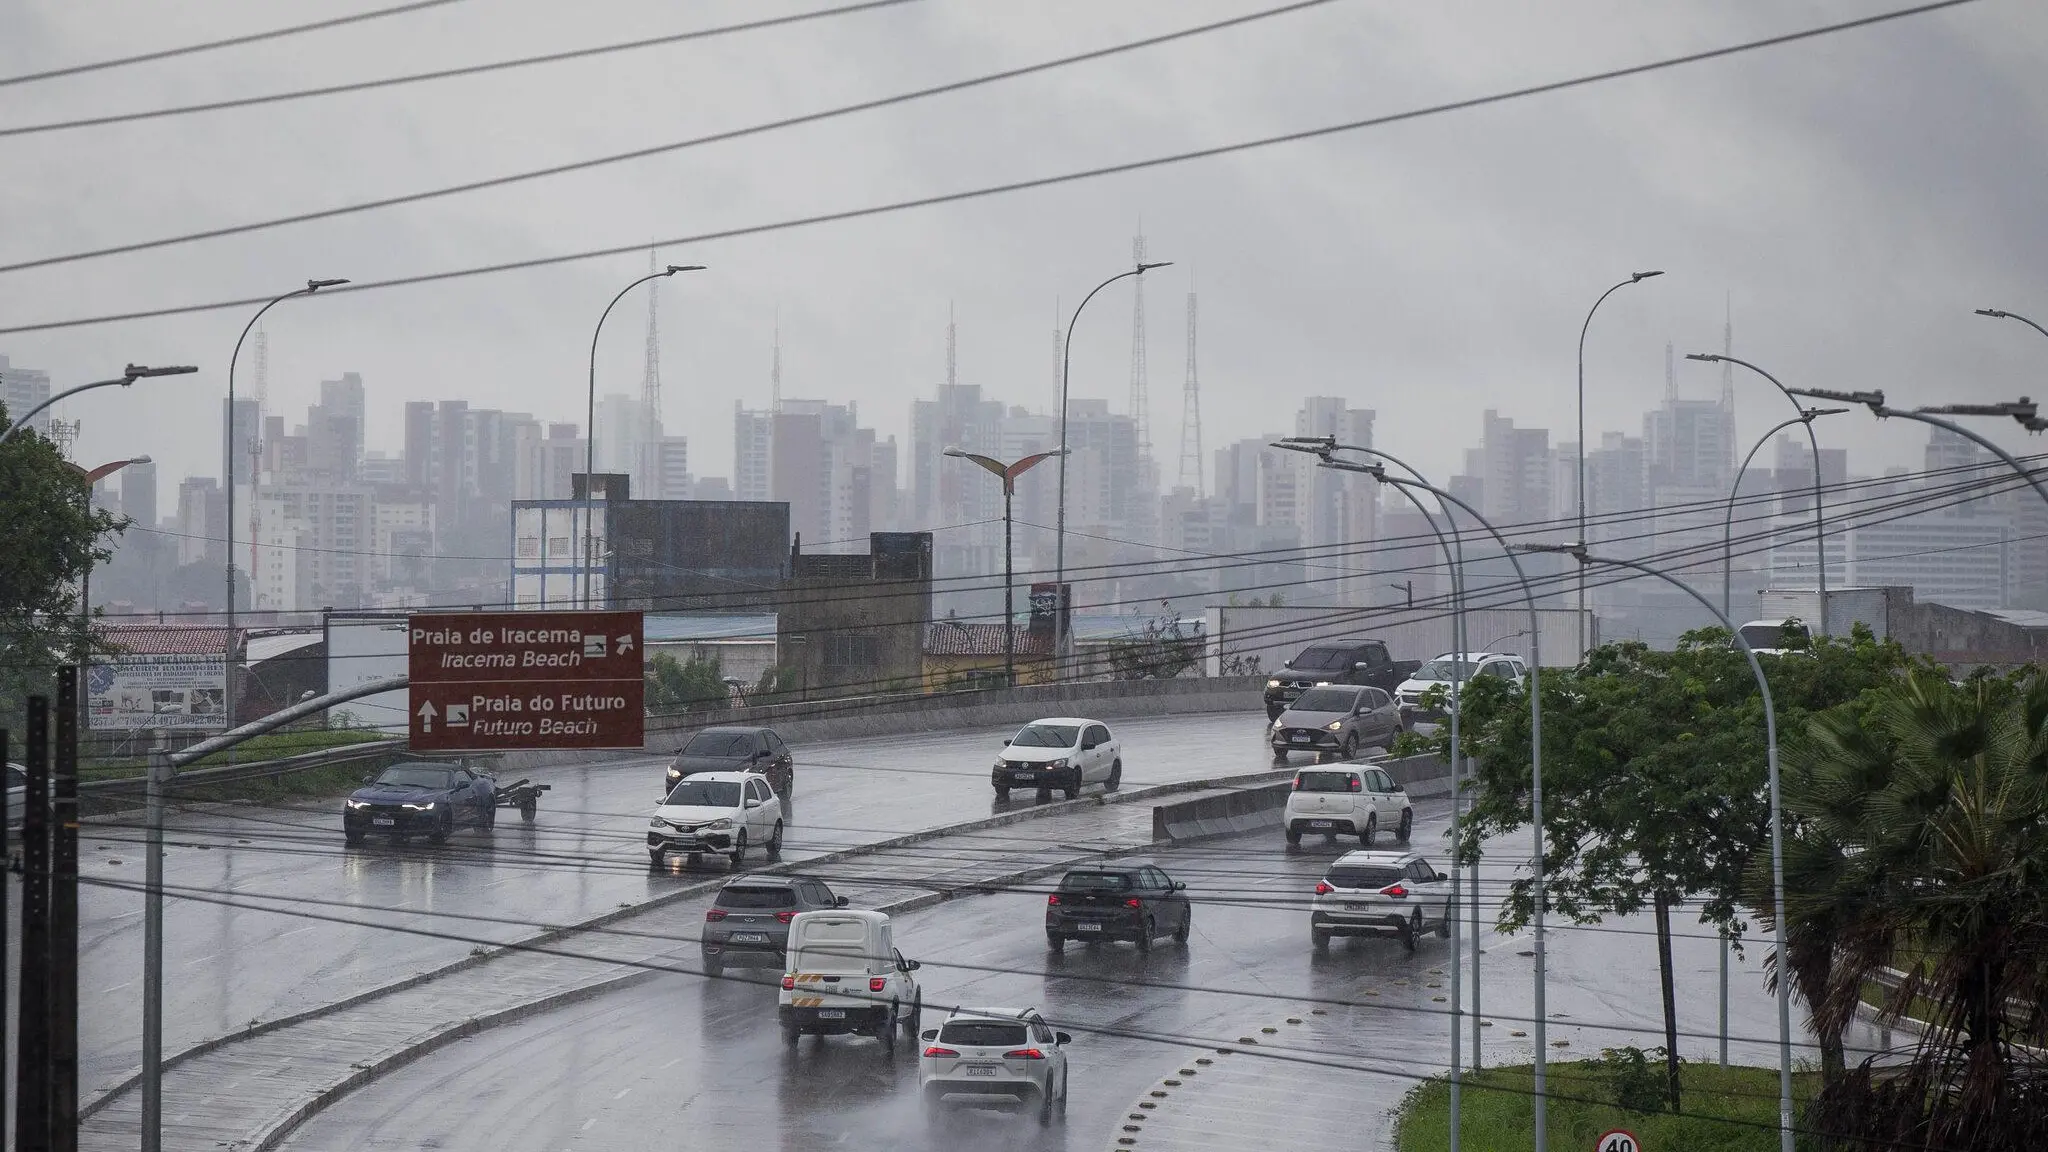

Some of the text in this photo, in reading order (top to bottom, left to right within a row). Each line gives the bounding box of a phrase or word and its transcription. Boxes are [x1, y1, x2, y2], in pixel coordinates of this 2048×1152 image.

[412, 627, 581, 645] Praia de Iracema
[441, 651, 581, 668] Iracema Beach
[472, 695, 625, 712] Praia do Futuro
[473, 718, 597, 735] Futuro Beach
[1605, 1139, 1632, 1152] 40
